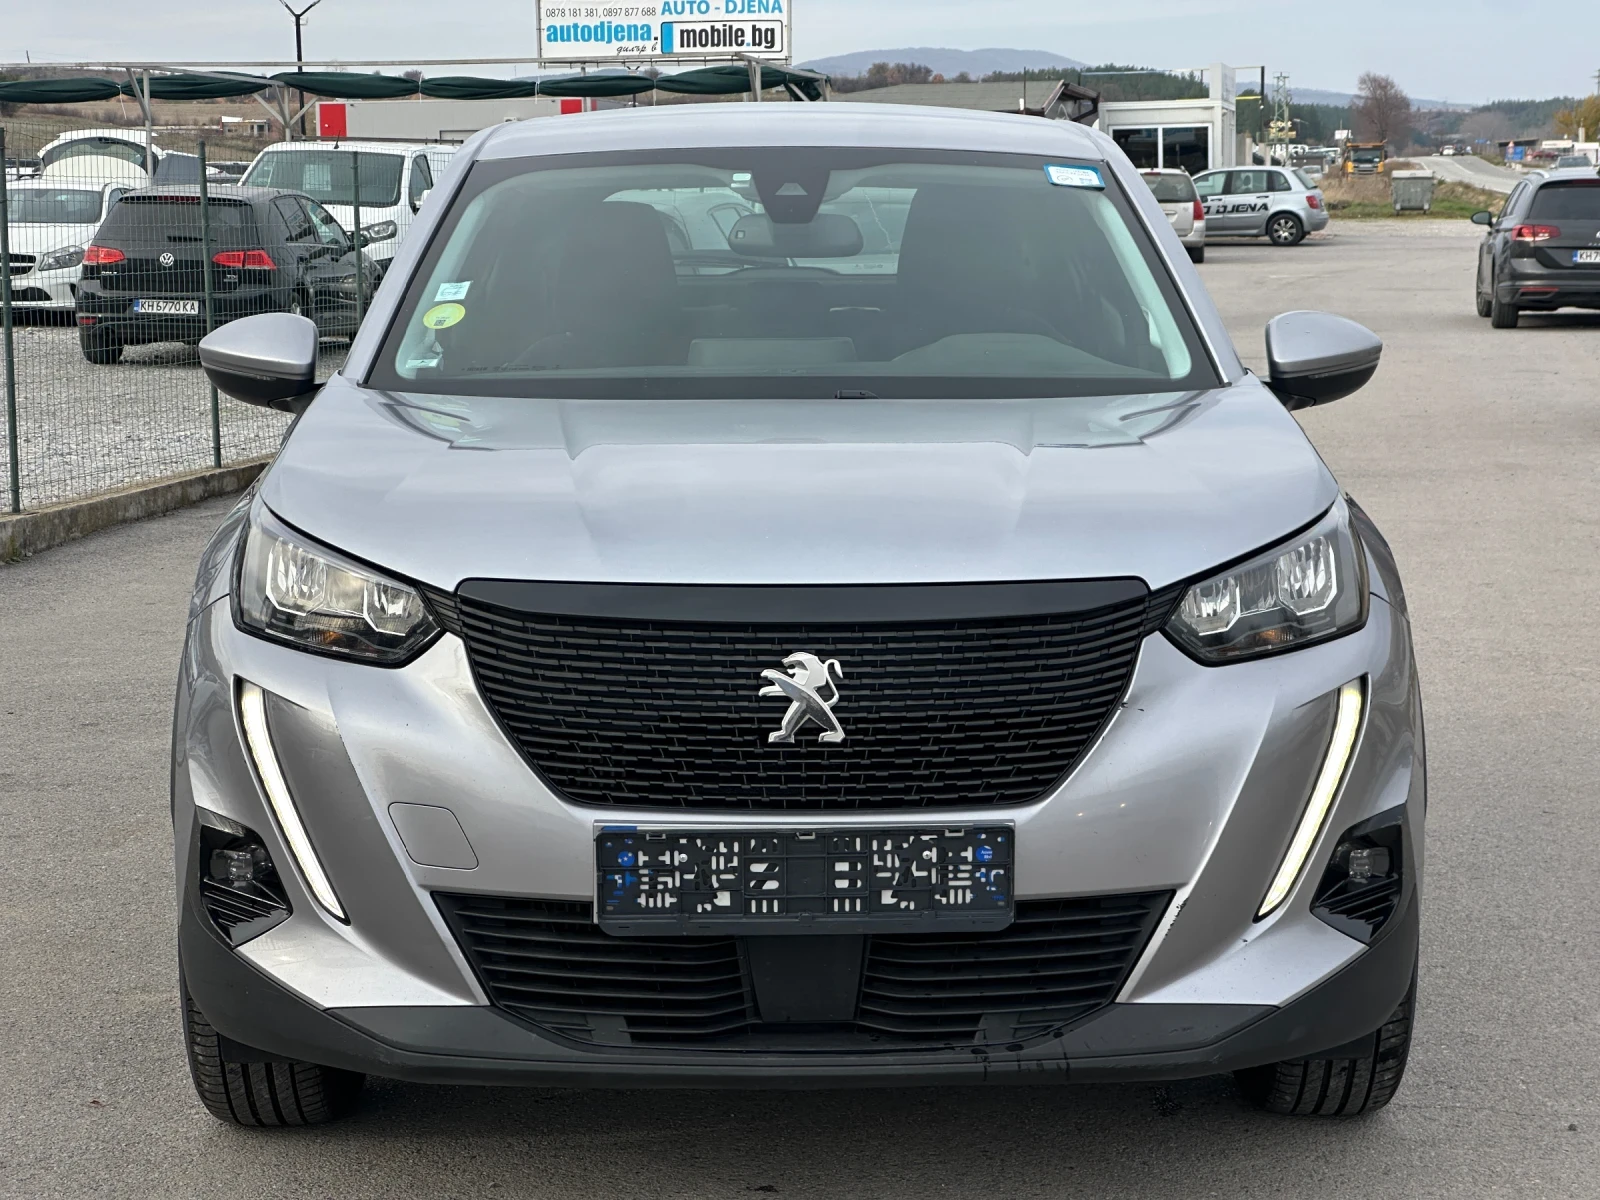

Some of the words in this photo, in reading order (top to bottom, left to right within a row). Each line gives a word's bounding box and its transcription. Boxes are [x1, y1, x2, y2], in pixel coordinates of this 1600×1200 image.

[546, 8, 566, 17] 0878
[568, 8, 581, 17] 181
[584, 8, 601, 18] 381,
[602, 7, 623, 17] 0897
[624, 7, 639, 17] 877
[641, 7, 656, 16] 688
[660, 1, 710, 16] AUTO
[725, 0, 783, 14] DJENA
[680, 24, 775, 49] mobile.bg
[1216, 203, 1269, 214] DJENA
